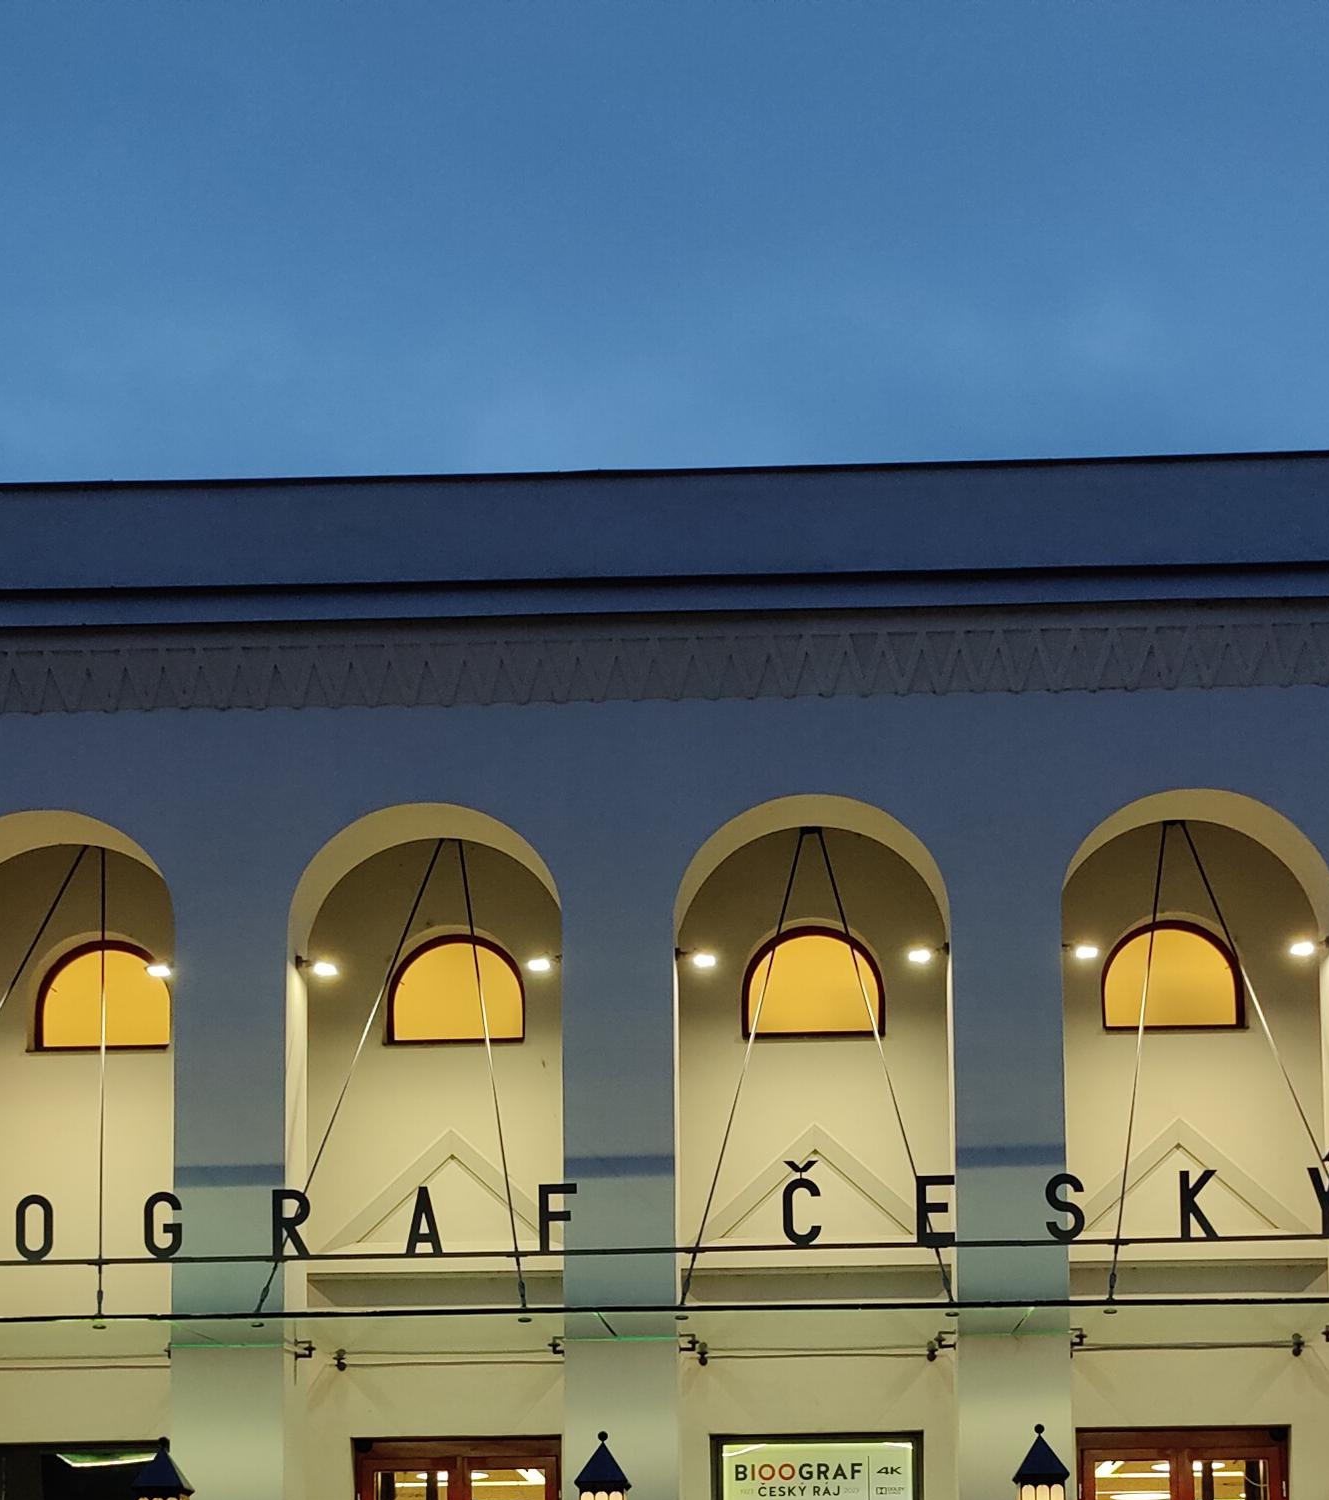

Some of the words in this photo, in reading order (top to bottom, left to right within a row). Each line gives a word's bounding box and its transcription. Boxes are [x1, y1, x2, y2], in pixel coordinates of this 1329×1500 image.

[735, 1462, 863, 1481] BIOOGRAF
[876, 1466, 902, 1475] 4K
[758, 1482, 807, 1497] ČESKÝ
[813, 1482, 840, 1497] RÁJ
